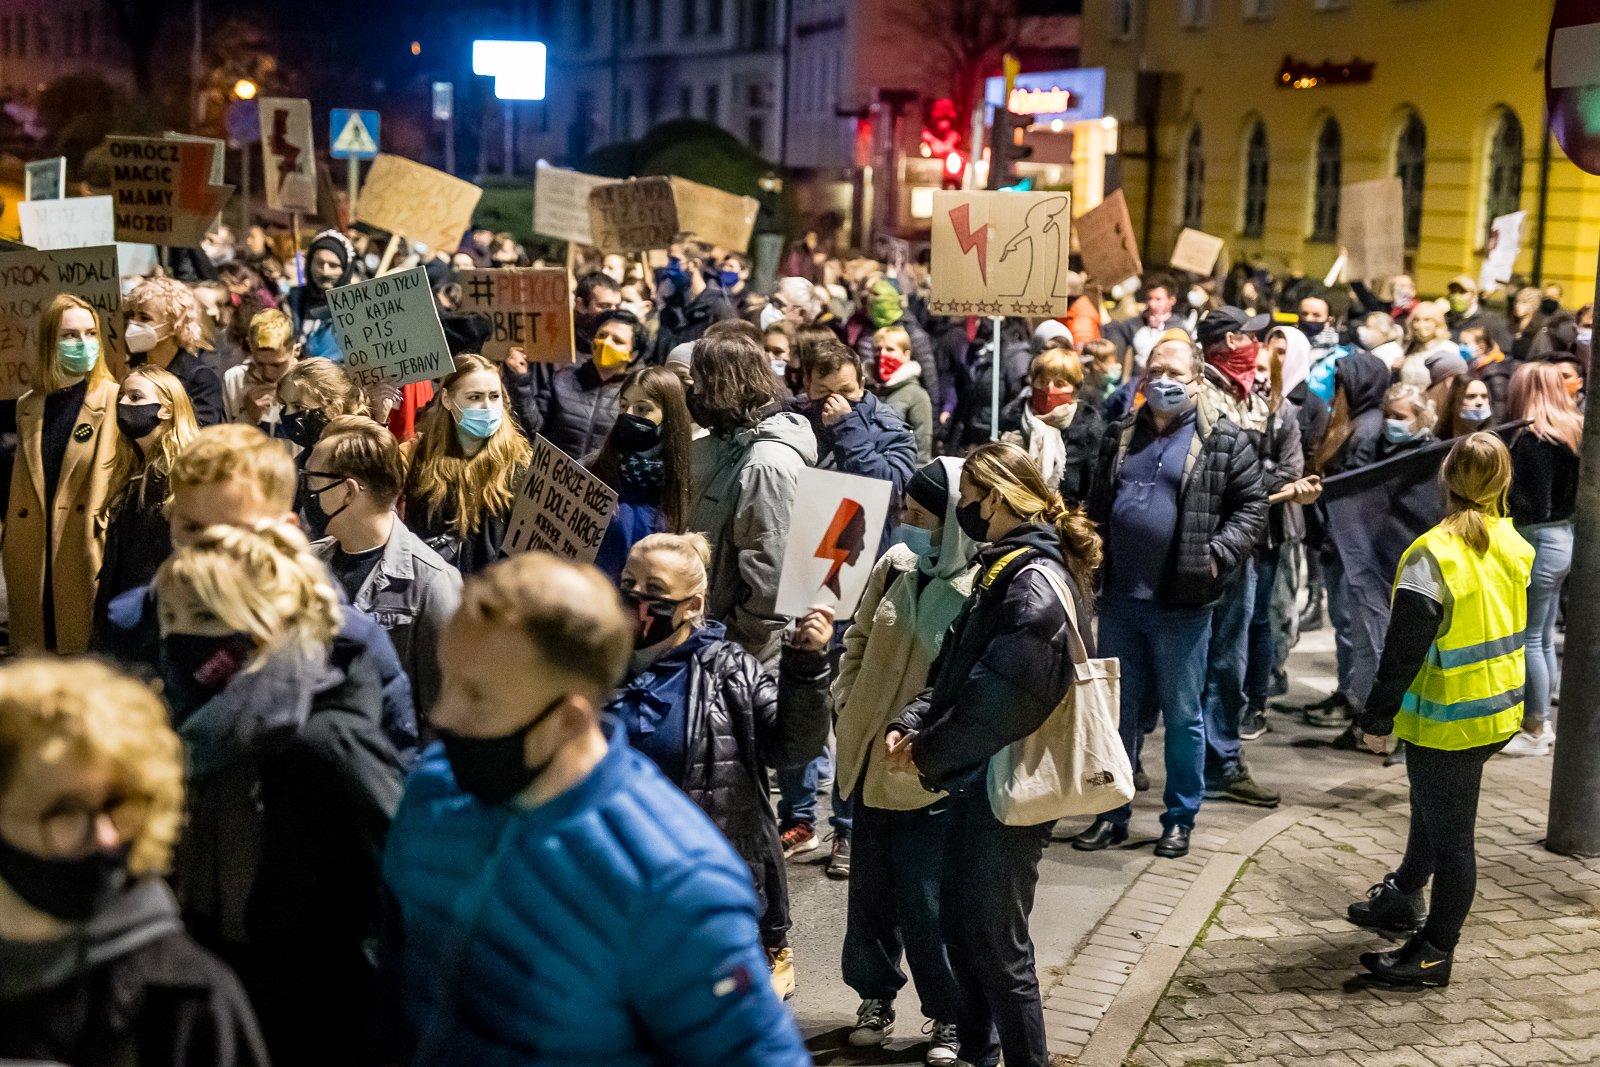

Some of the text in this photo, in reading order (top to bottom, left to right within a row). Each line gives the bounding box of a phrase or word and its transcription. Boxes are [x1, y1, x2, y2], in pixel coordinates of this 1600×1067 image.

[114, 165, 172, 183] MACIC
[118, 189, 173, 206] MAMY
[0, 265, 49, 288] YROK
[331, 273, 419, 311] KAJAK OD TYŁU
[336, 298, 405, 328] TO KAJAK
[344, 321, 393, 349] A PIS
[349, 338, 407, 367] OD TYŁU
[394, 351, 439, 382] JEBANY
[532, 443, 551, 475] NA
[523, 473, 544, 504] NA
[543, 485, 571, 522] DOLE
